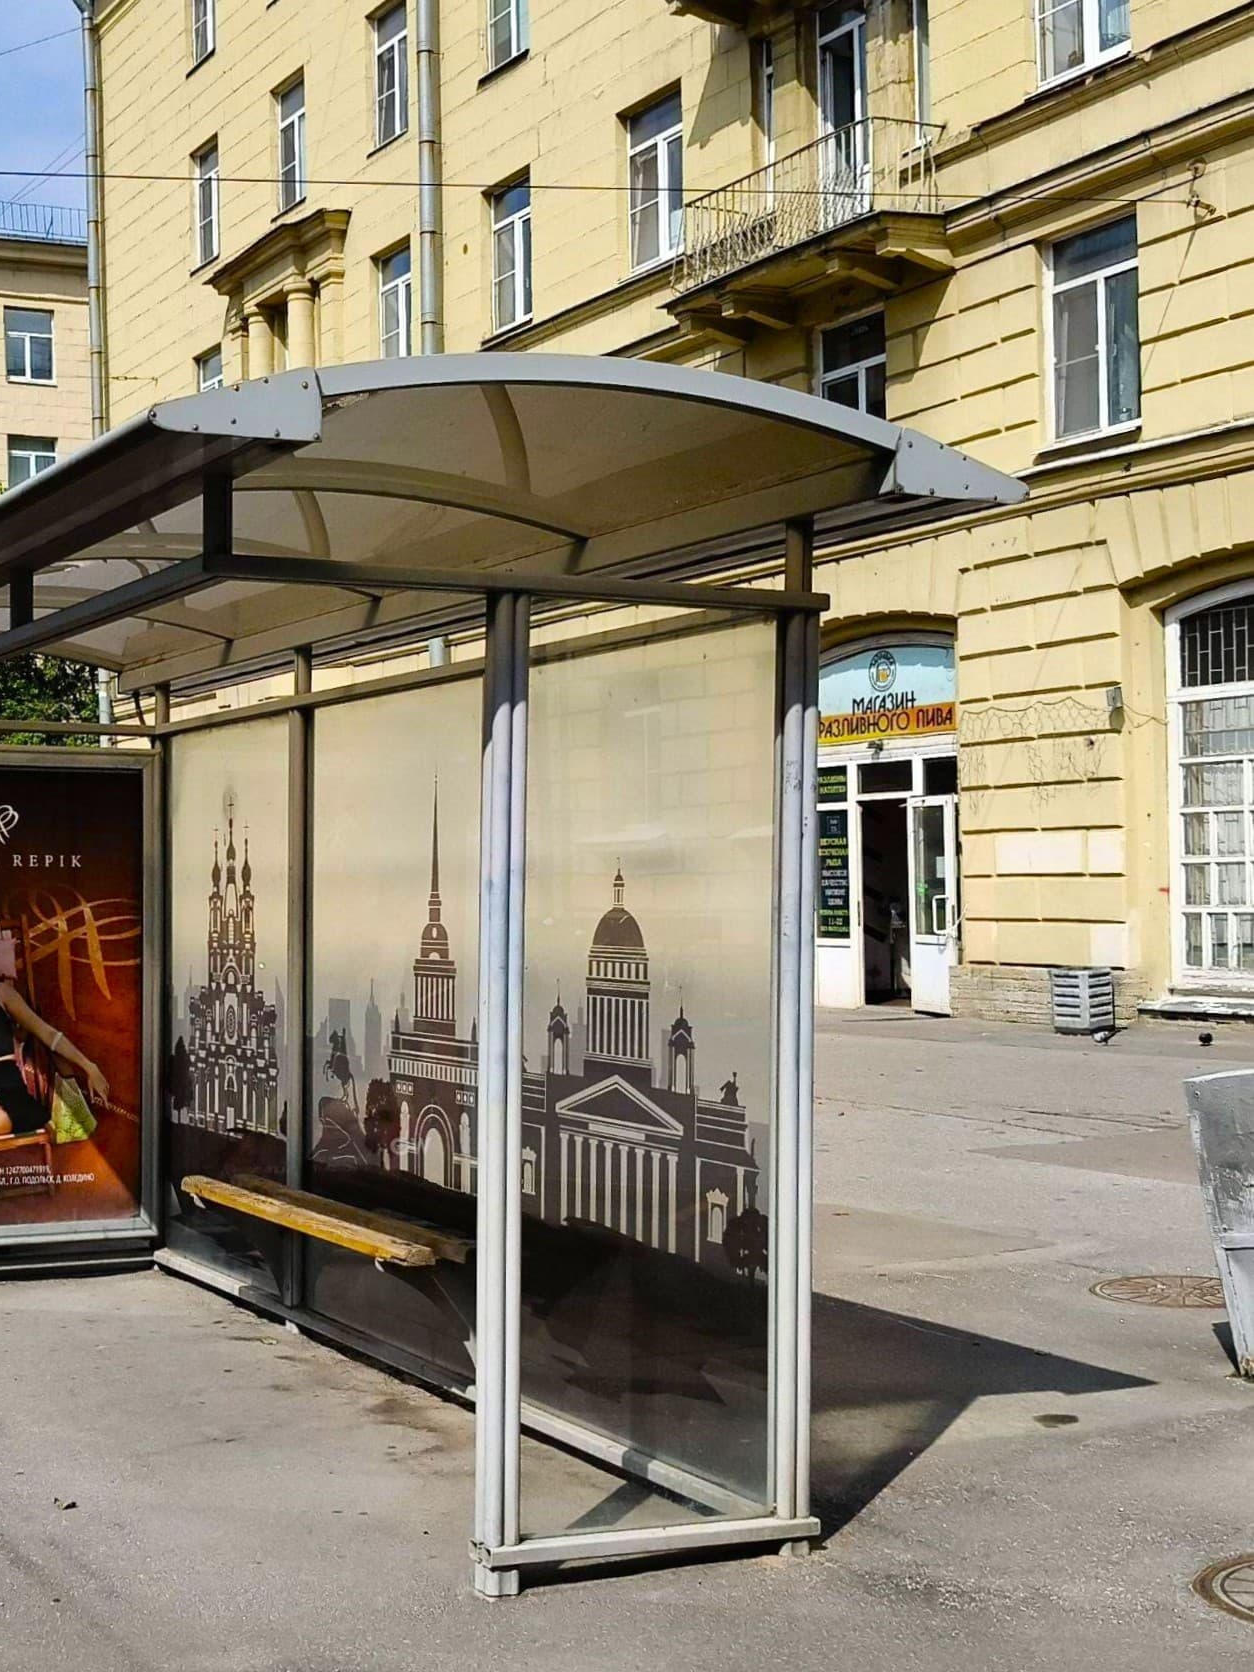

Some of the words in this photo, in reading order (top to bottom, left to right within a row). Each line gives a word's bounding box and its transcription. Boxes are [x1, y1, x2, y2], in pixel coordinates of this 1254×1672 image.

[852, 690, 916, 716] МАГАЗИН
[818, 711, 910, 739] РАЗЛИВНОГО
[916, 707, 953, 729] ПИВА
[12, 854, 82, 868] REPIK
